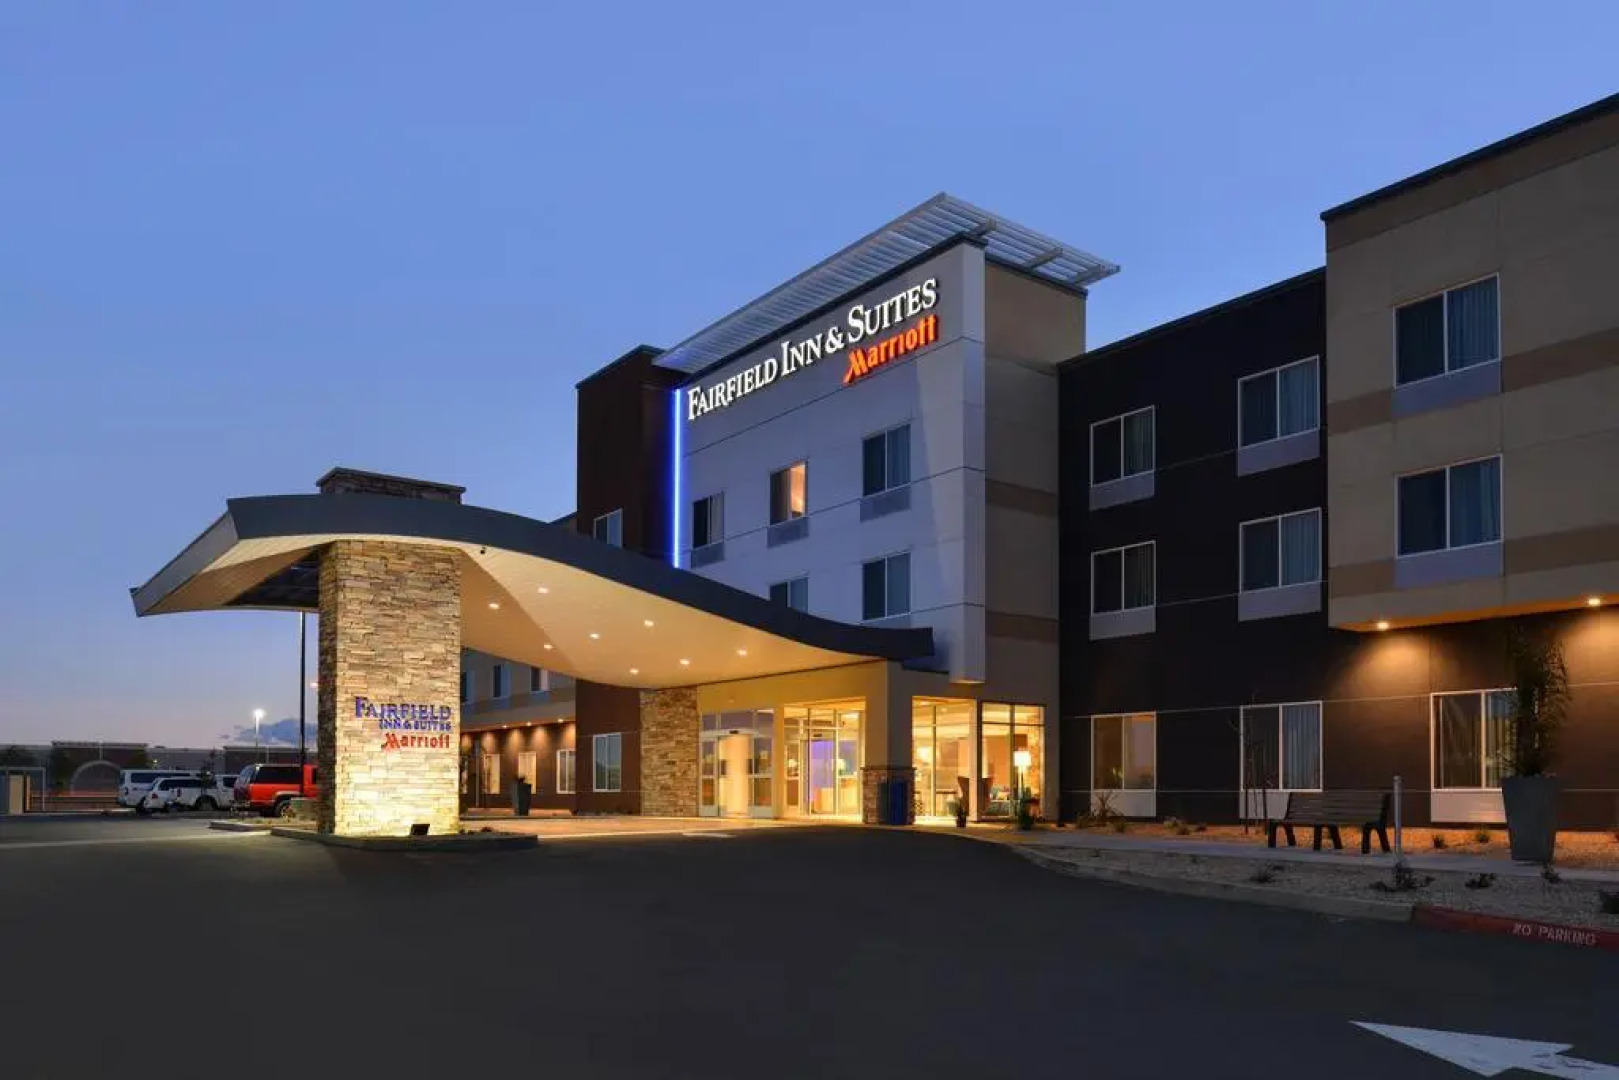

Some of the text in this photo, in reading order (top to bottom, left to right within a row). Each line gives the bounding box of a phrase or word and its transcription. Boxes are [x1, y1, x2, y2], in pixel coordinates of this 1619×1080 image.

[687, 358, 778, 420] FAIRFIELD
[780, 333, 822, 376] INN
[847, 278, 937, 344] SUITES
[842, 314, 938, 386] Marriott
[354, 696, 452, 720] FAIRFIELD
[380, 732, 450, 750] Marriott
